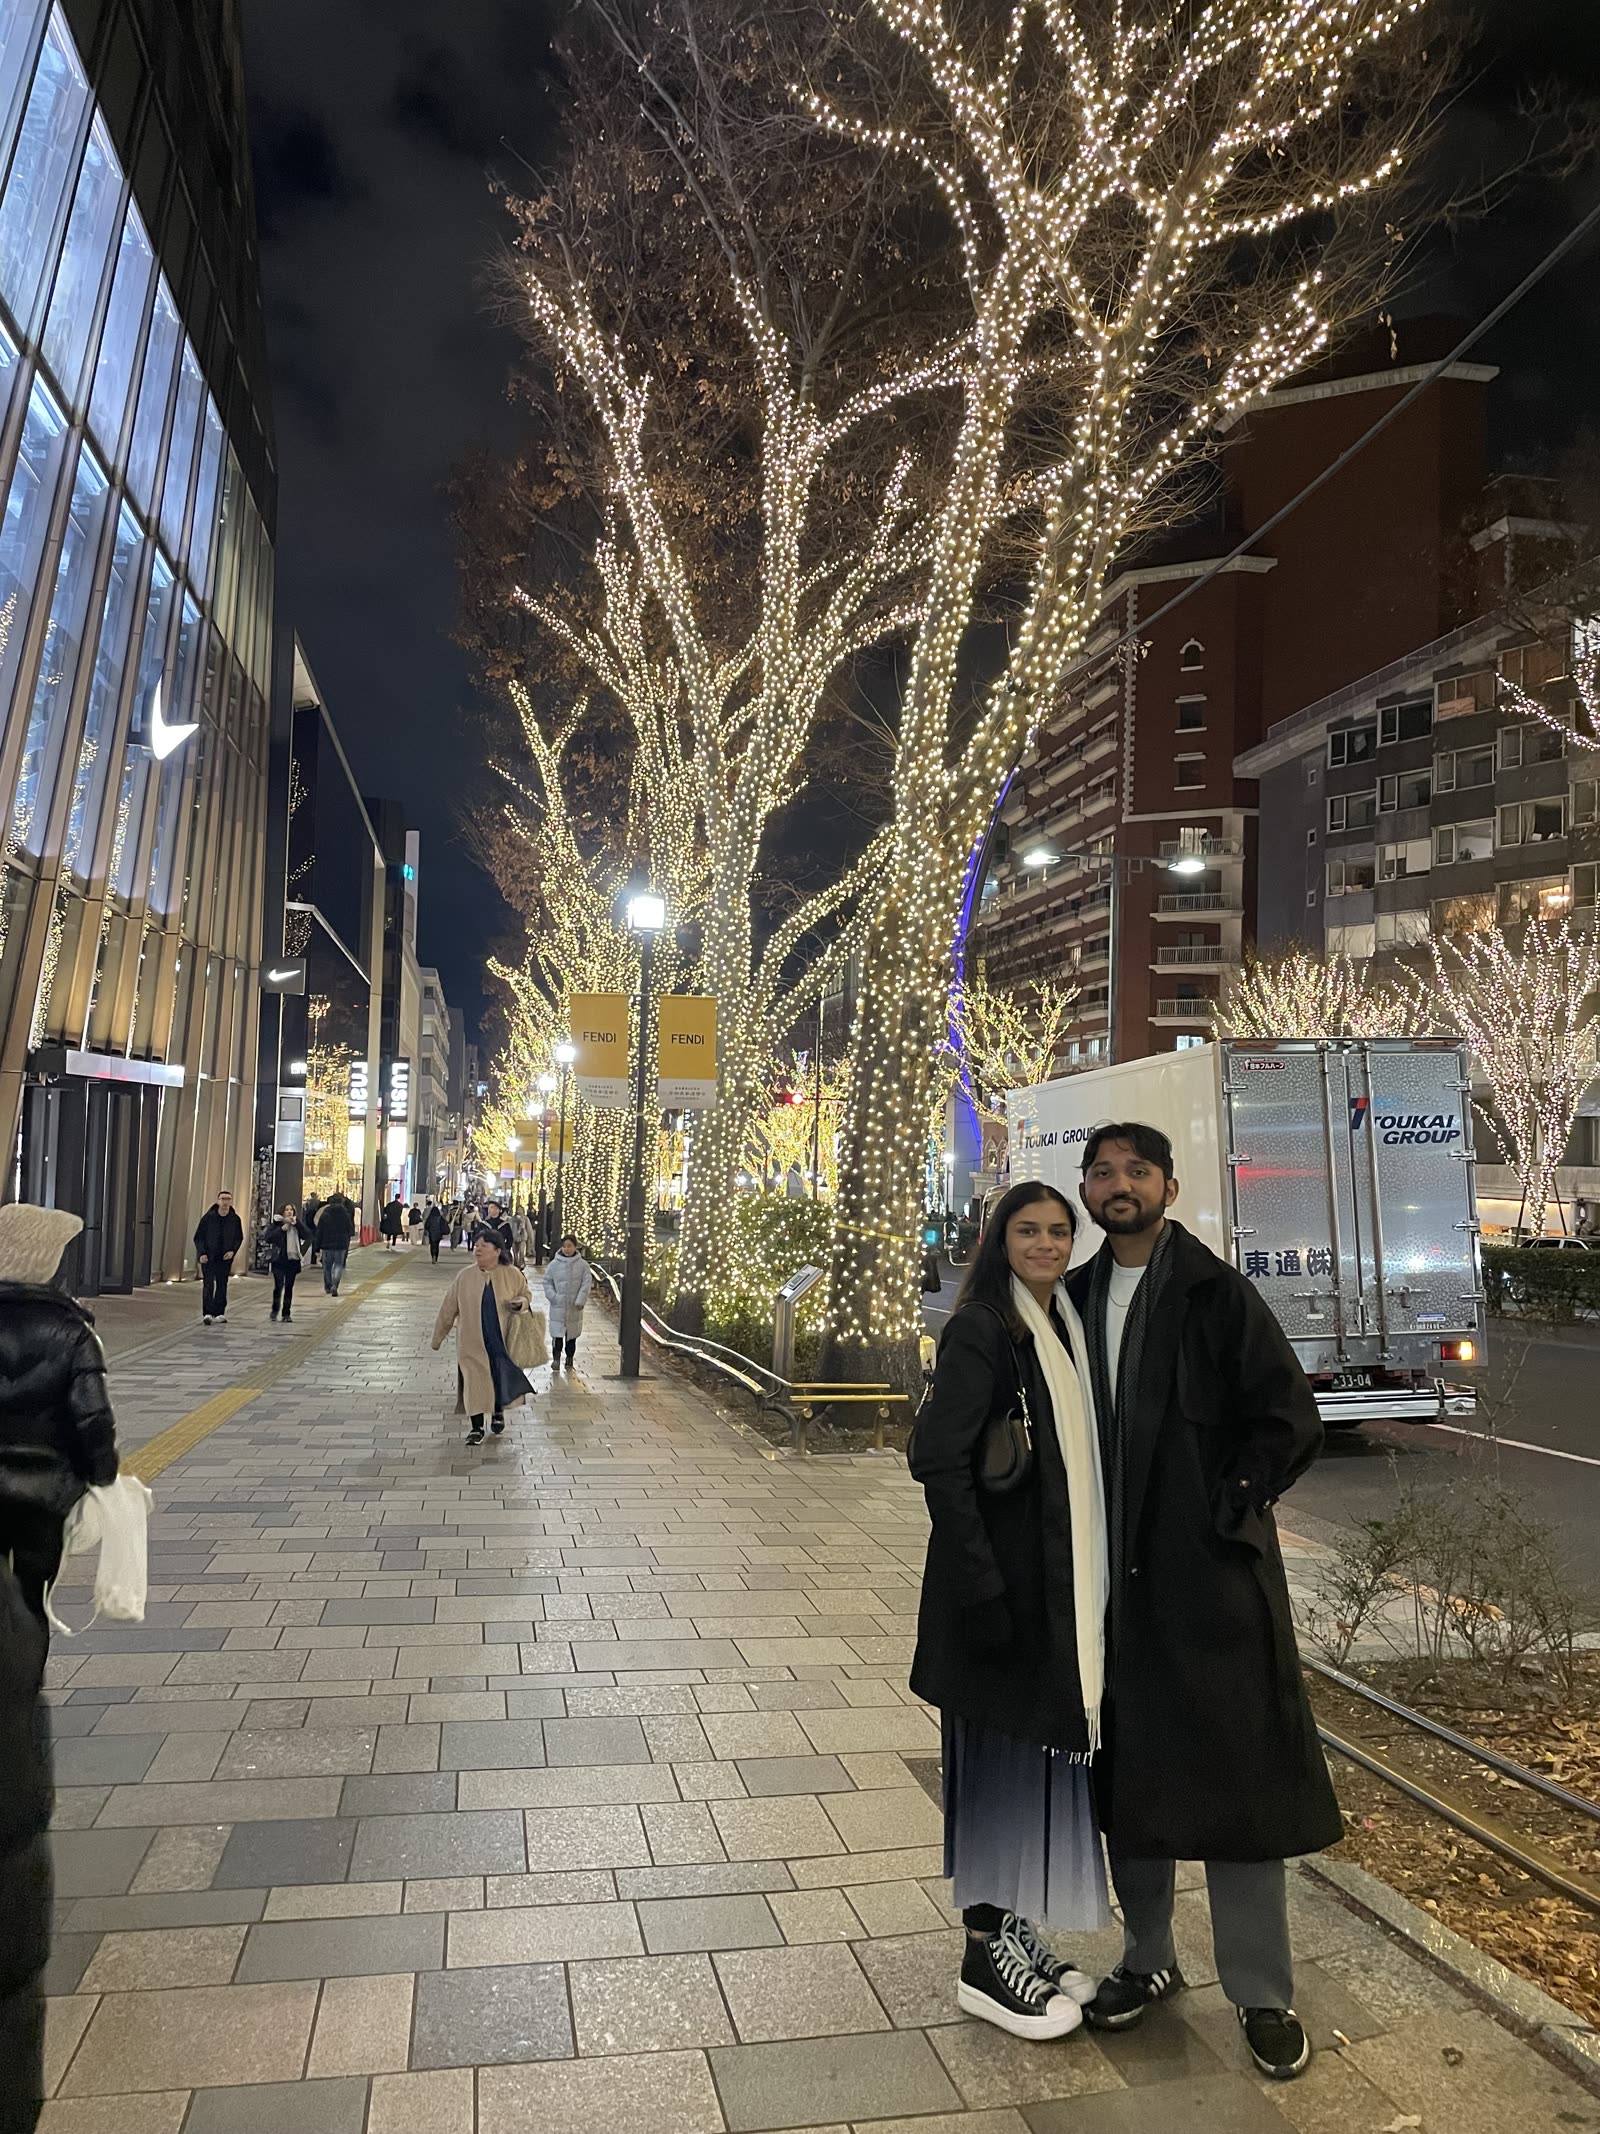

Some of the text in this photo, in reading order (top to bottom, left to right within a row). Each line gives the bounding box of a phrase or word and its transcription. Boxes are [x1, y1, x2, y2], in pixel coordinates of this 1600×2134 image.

[583, 1032, 616, 1043] FENDI
[671, 1033, 705, 1045] FENDI
[390, 1062, 409, 1117] LUSH
[1025, 1131, 1058, 1149] TOUKAI
[1383, 1130, 1461, 1145] GROUP
[1339, 1373, 1372, 1387] 33-04
